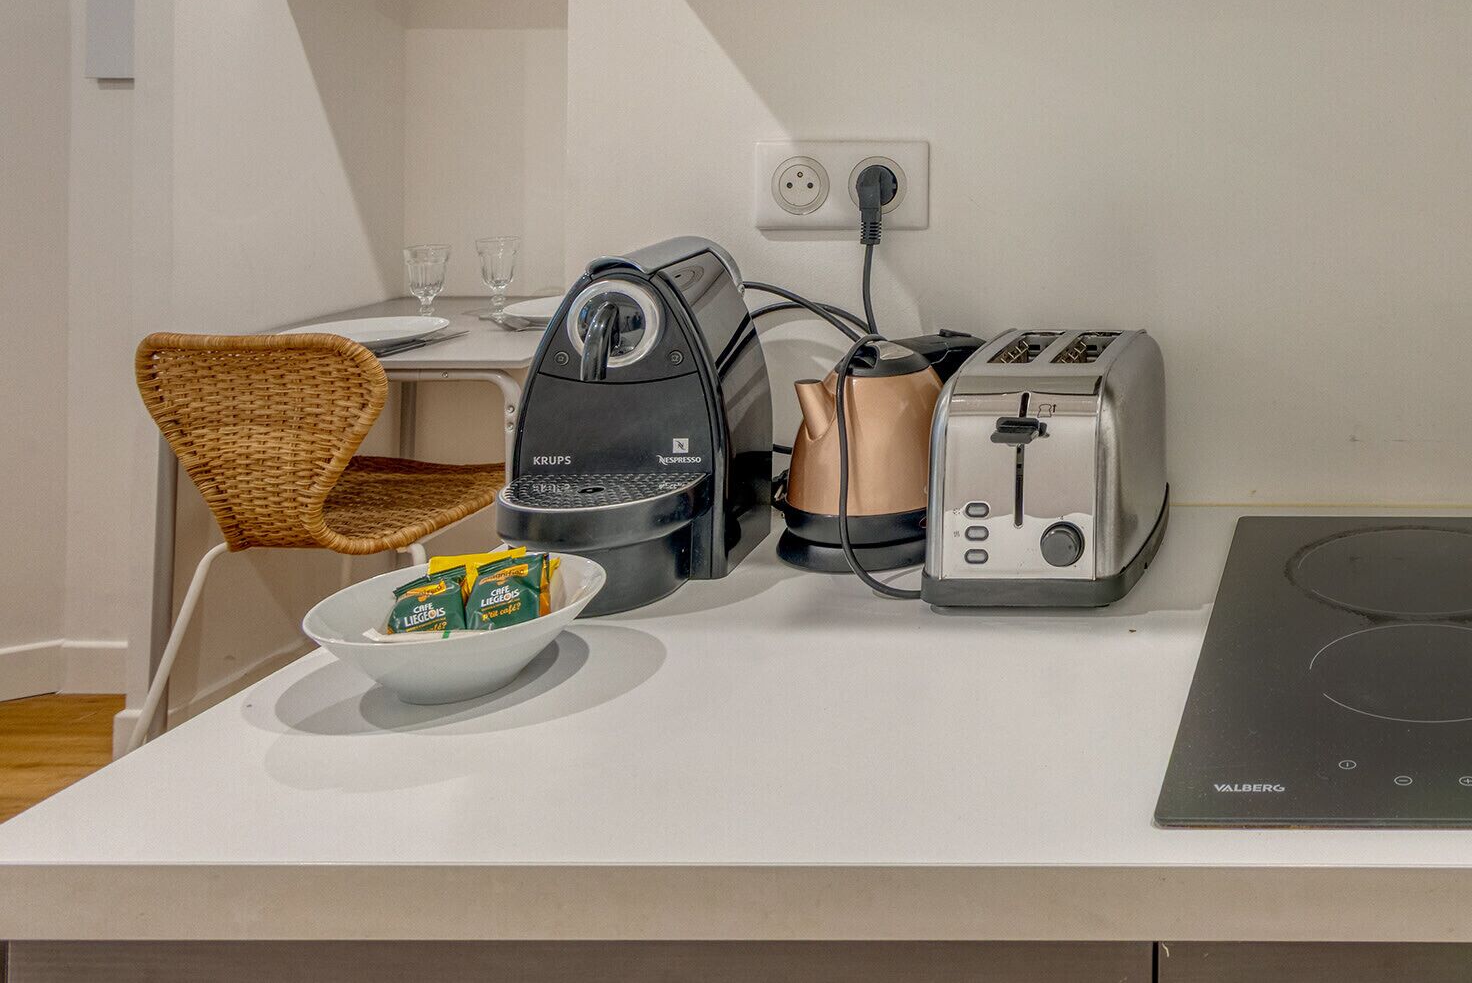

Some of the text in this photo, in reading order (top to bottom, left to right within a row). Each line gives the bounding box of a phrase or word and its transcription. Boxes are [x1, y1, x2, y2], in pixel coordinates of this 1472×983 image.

[533, 455, 572, 465] KRUPS
[480, 588, 521, 608] LIEGEOIS
[403, 607, 446, 628] LIEGEOIS
[1213, 783, 1286, 793] VALBERG
